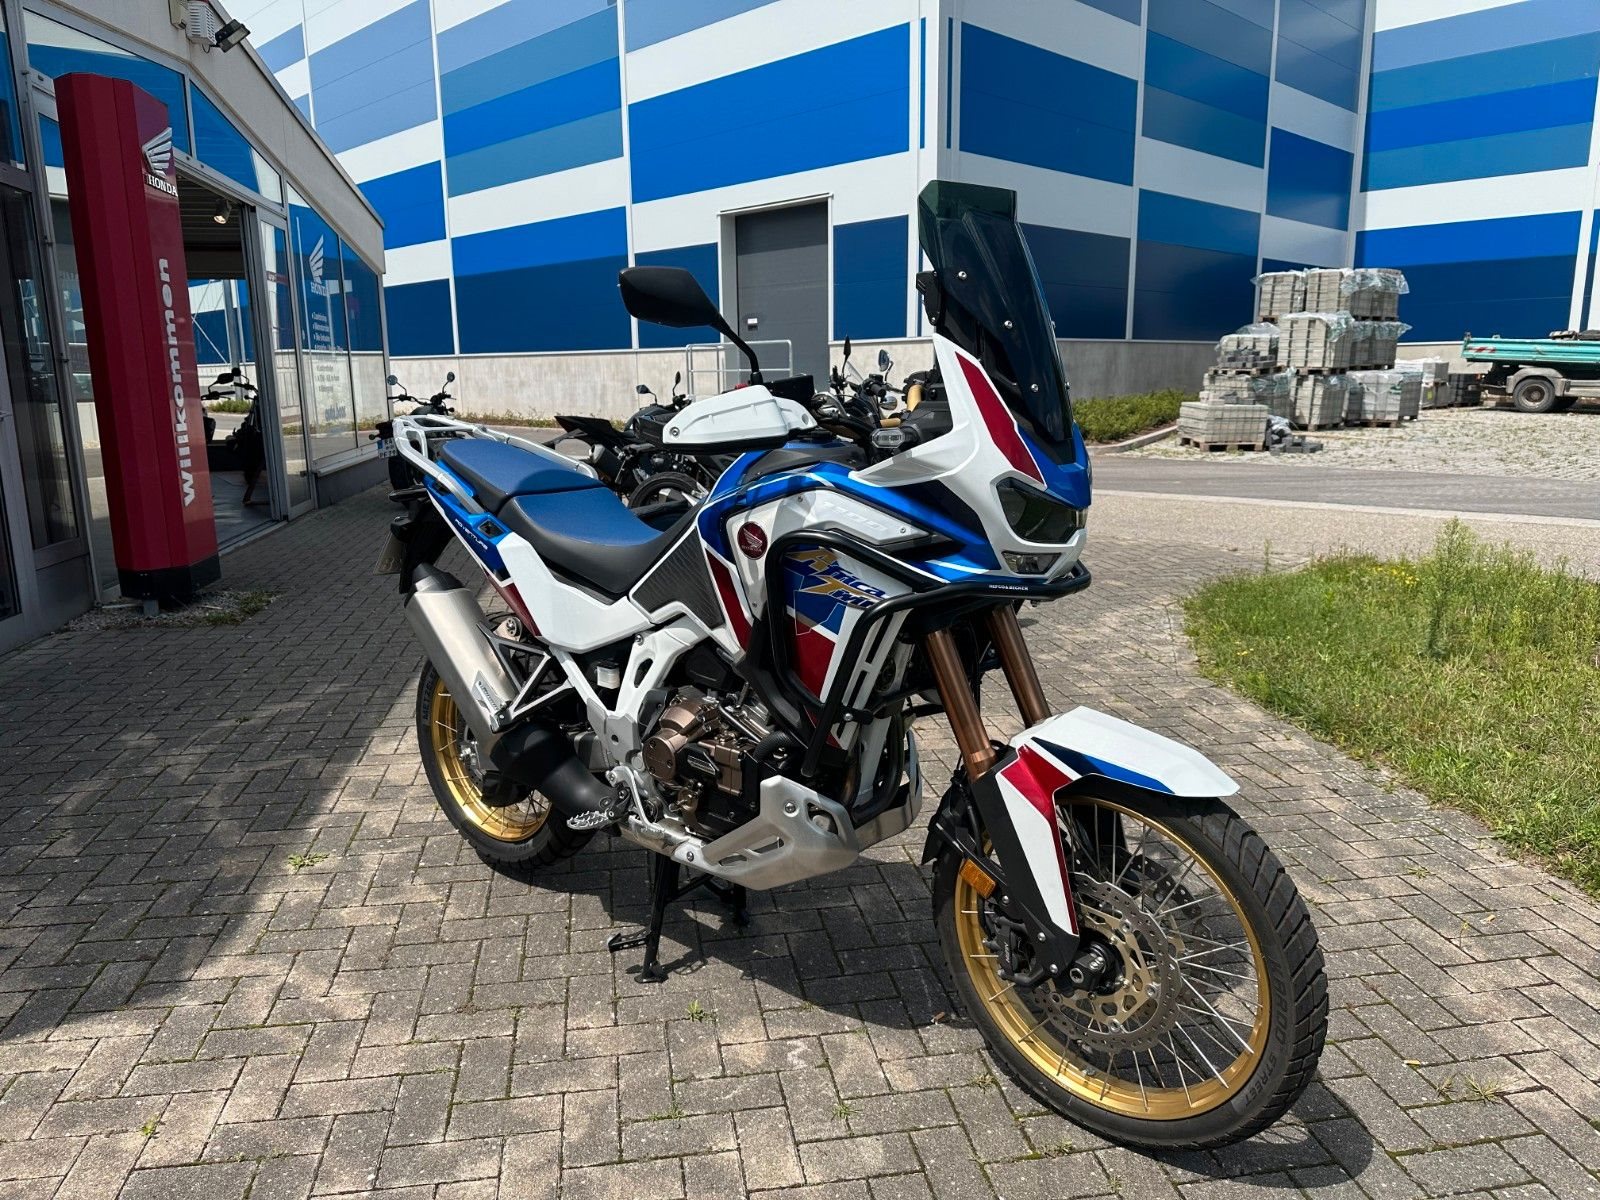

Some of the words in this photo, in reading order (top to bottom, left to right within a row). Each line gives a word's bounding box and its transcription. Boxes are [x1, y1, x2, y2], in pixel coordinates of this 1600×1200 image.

[147, 173, 179, 198] HONDA
[158, 258, 196, 507] willkommen
[1244, 1052, 1278, 1108] STREET
